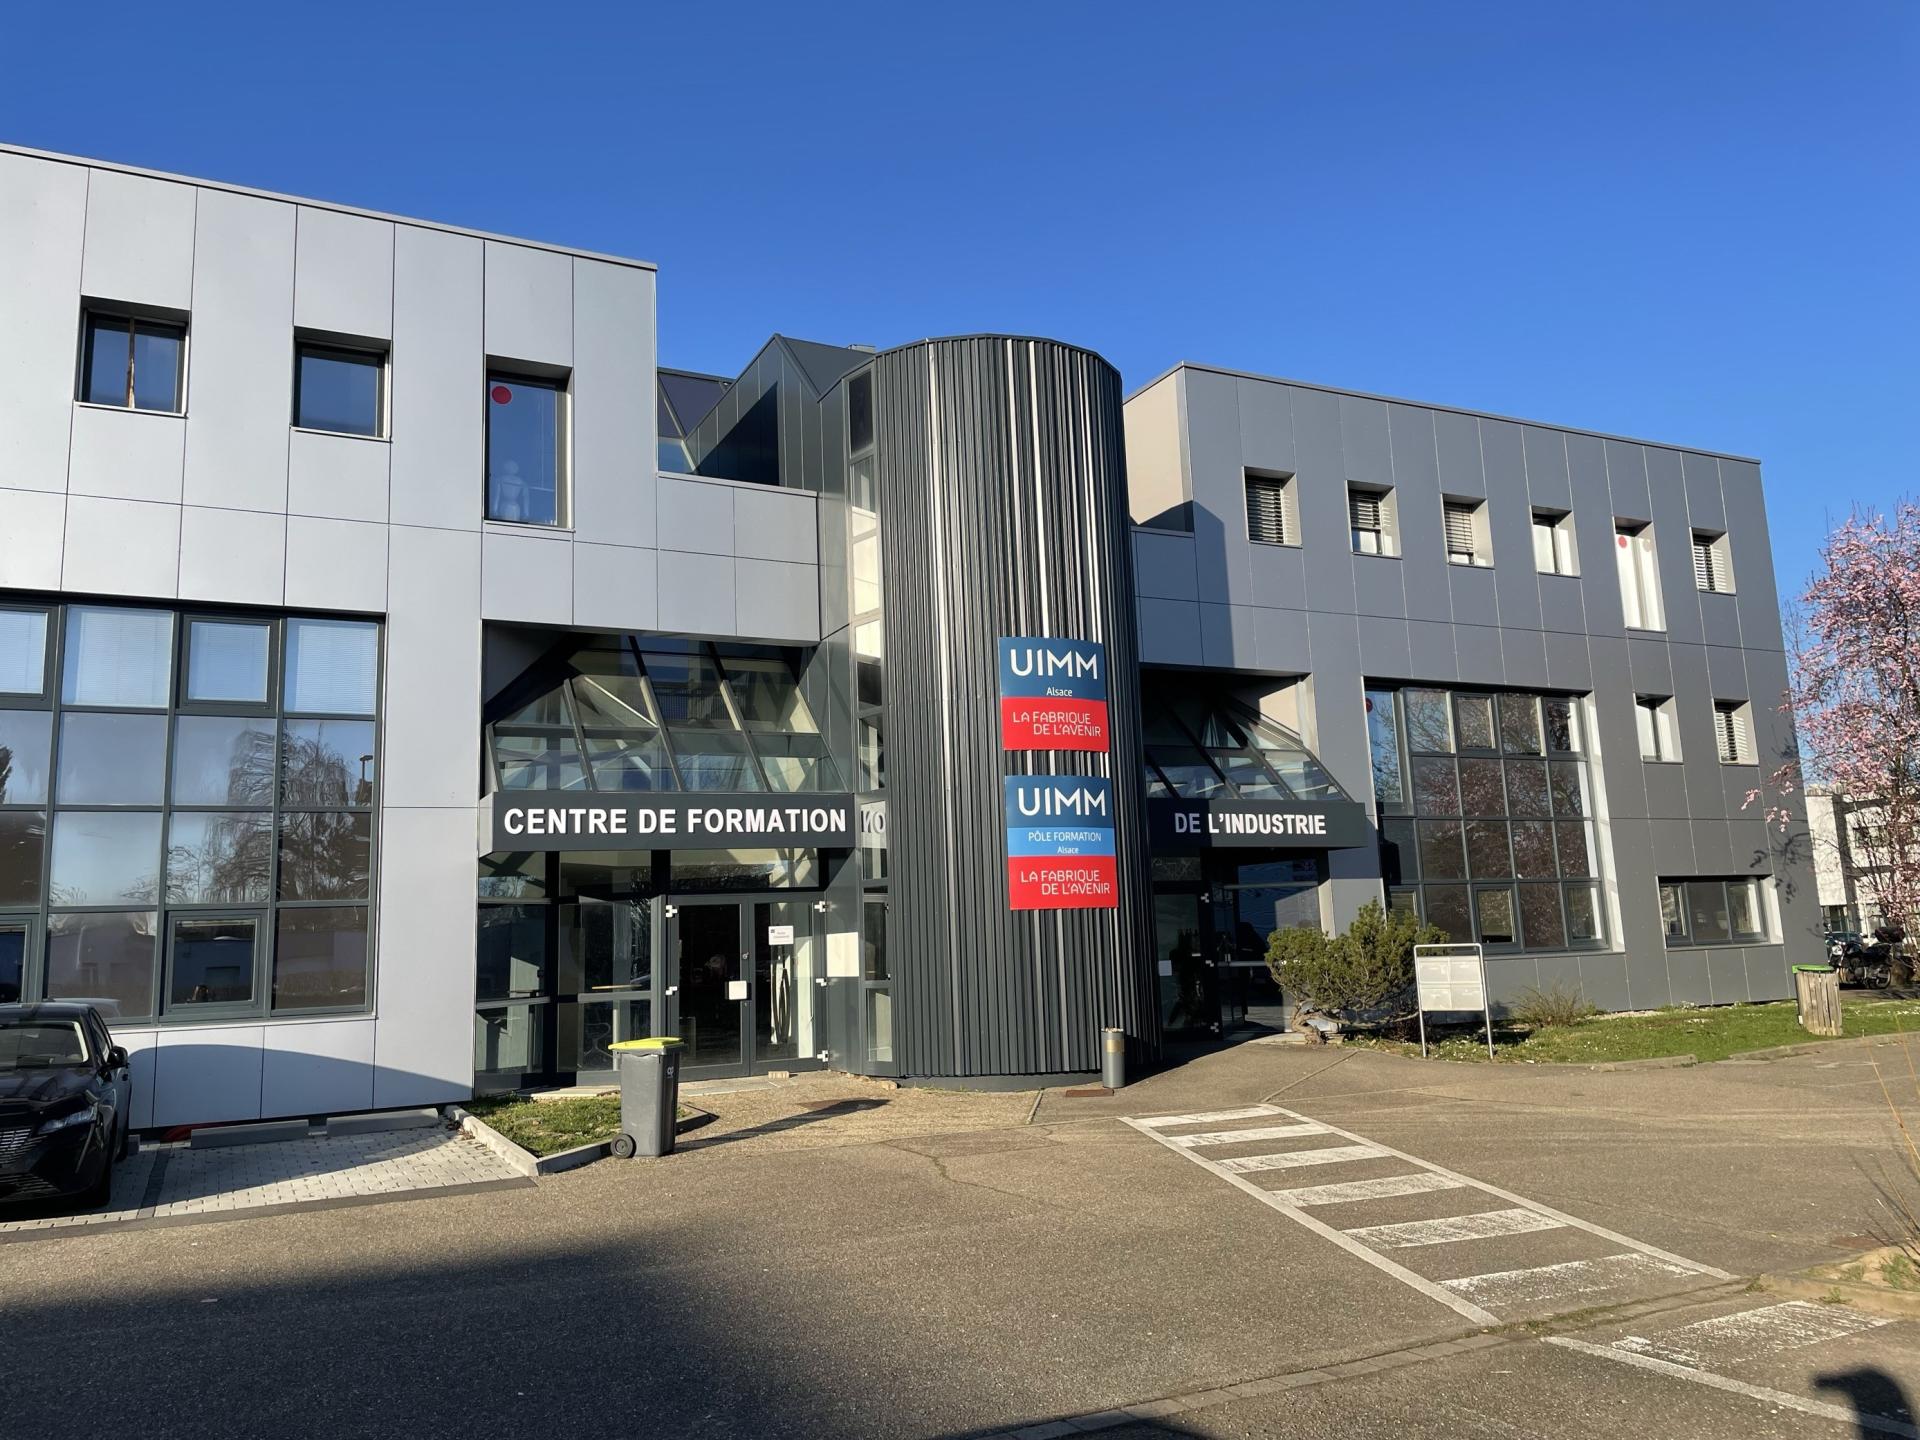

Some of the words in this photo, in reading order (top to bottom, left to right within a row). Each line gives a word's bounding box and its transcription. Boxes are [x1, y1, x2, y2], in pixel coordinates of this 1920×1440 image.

[1010, 648, 1098, 679] UIMM
[1046, 687, 1073, 697] Alsace
[1012, 711, 1030, 723] LA
[1032, 711, 1092, 725] FABRIQUE
[1033, 724, 1051, 735] DE
[1053, 724, 1101, 737] L'AVENIR
[1018, 787, 1106, 816] UIMM
[504, 808, 628, 835] CENTRE
[638, 808, 677, 834] DE
[688, 808, 847, 834] FORMATION
[1174, 812, 1201, 833] DE
[1207, 813, 1327, 835] L'INDUSTRIE
[1028, 829, 1051, 842] PÔLE
[1053, 831, 1102, 842] FORMATION
[1057, 845, 1079, 855] Alsace
[1020, 871, 1038, 882] LA
[1041, 870, 1100, 883] FABRIQUE
[1041, 883, 1059, 895] DE
[1062, 883, 1110, 895] L'AVENIR
